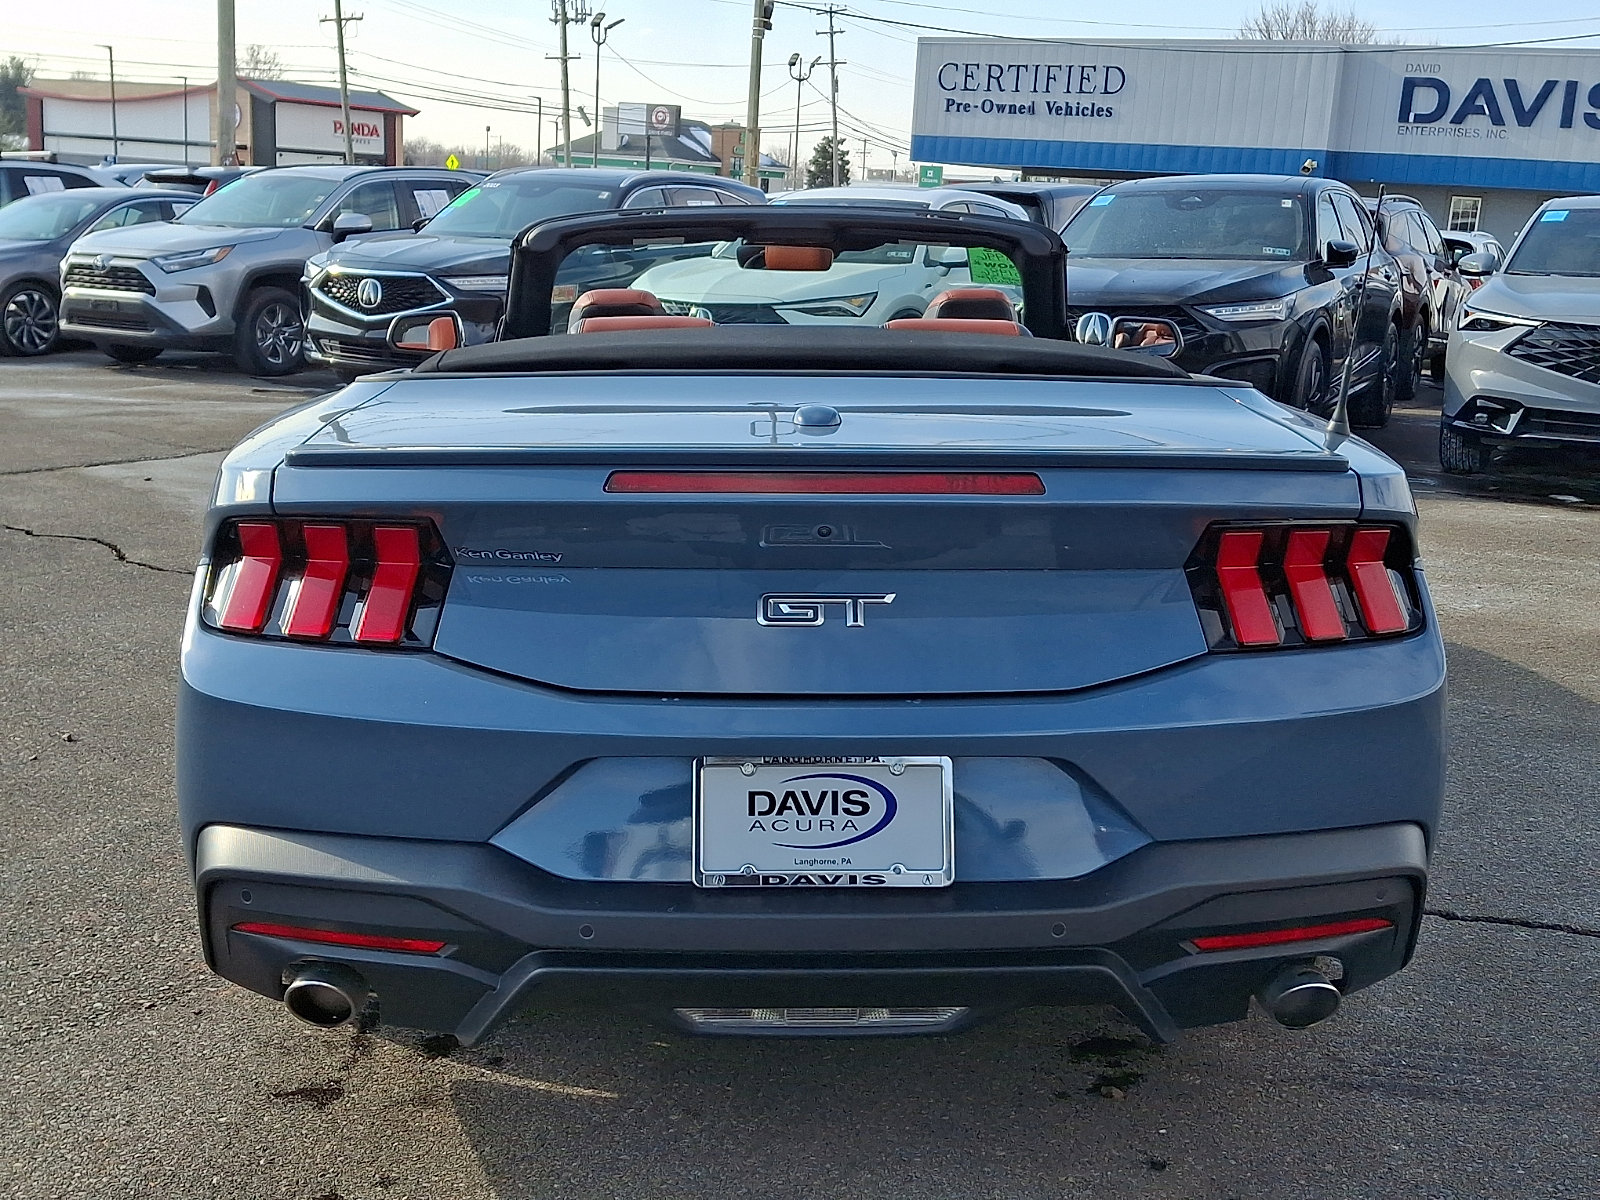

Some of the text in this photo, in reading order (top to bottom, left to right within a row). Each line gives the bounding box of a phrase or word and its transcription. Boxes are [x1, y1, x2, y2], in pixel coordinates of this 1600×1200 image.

[1405, 63, 1441, 74] DAVID
[938, 62, 1126, 95] CERTIFIED
[944, 98, 1113, 118] Pre-Owned Vehicles
[1397, 125, 1509, 140] ENTERPRISES, INC.
[454, 545, 563, 563] Ken Ganley
[756, 592, 897, 627] GT
[747, 789, 871, 817] DAVIS
[748, 819, 860, 832] ACURA
[794, 857, 852, 867] Langhorne, PA
[761, 874, 887, 886] DAVIS
